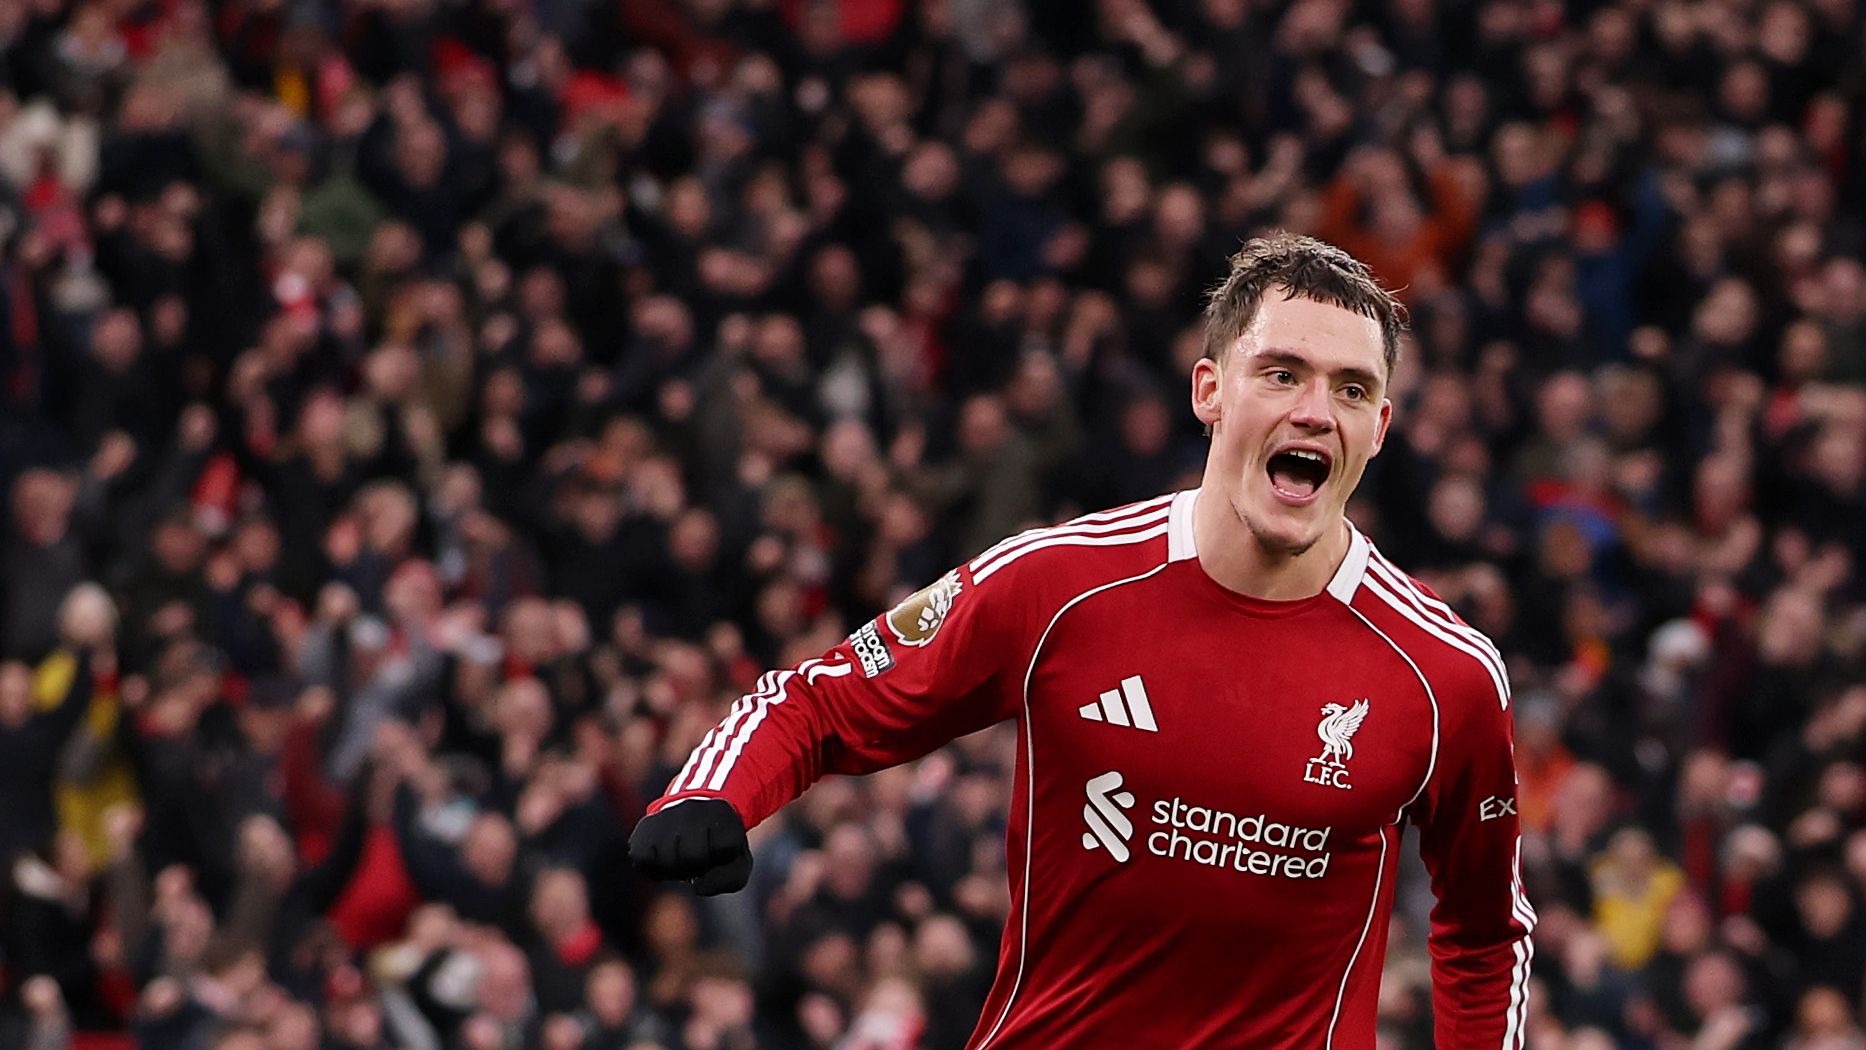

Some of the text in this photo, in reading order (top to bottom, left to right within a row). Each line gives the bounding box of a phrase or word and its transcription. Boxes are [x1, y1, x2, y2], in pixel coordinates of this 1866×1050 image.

[1303, 763, 1352, 789] L.F.C.
[1151, 796, 1331, 851] standard
[1148, 828, 1330, 879] chartered
